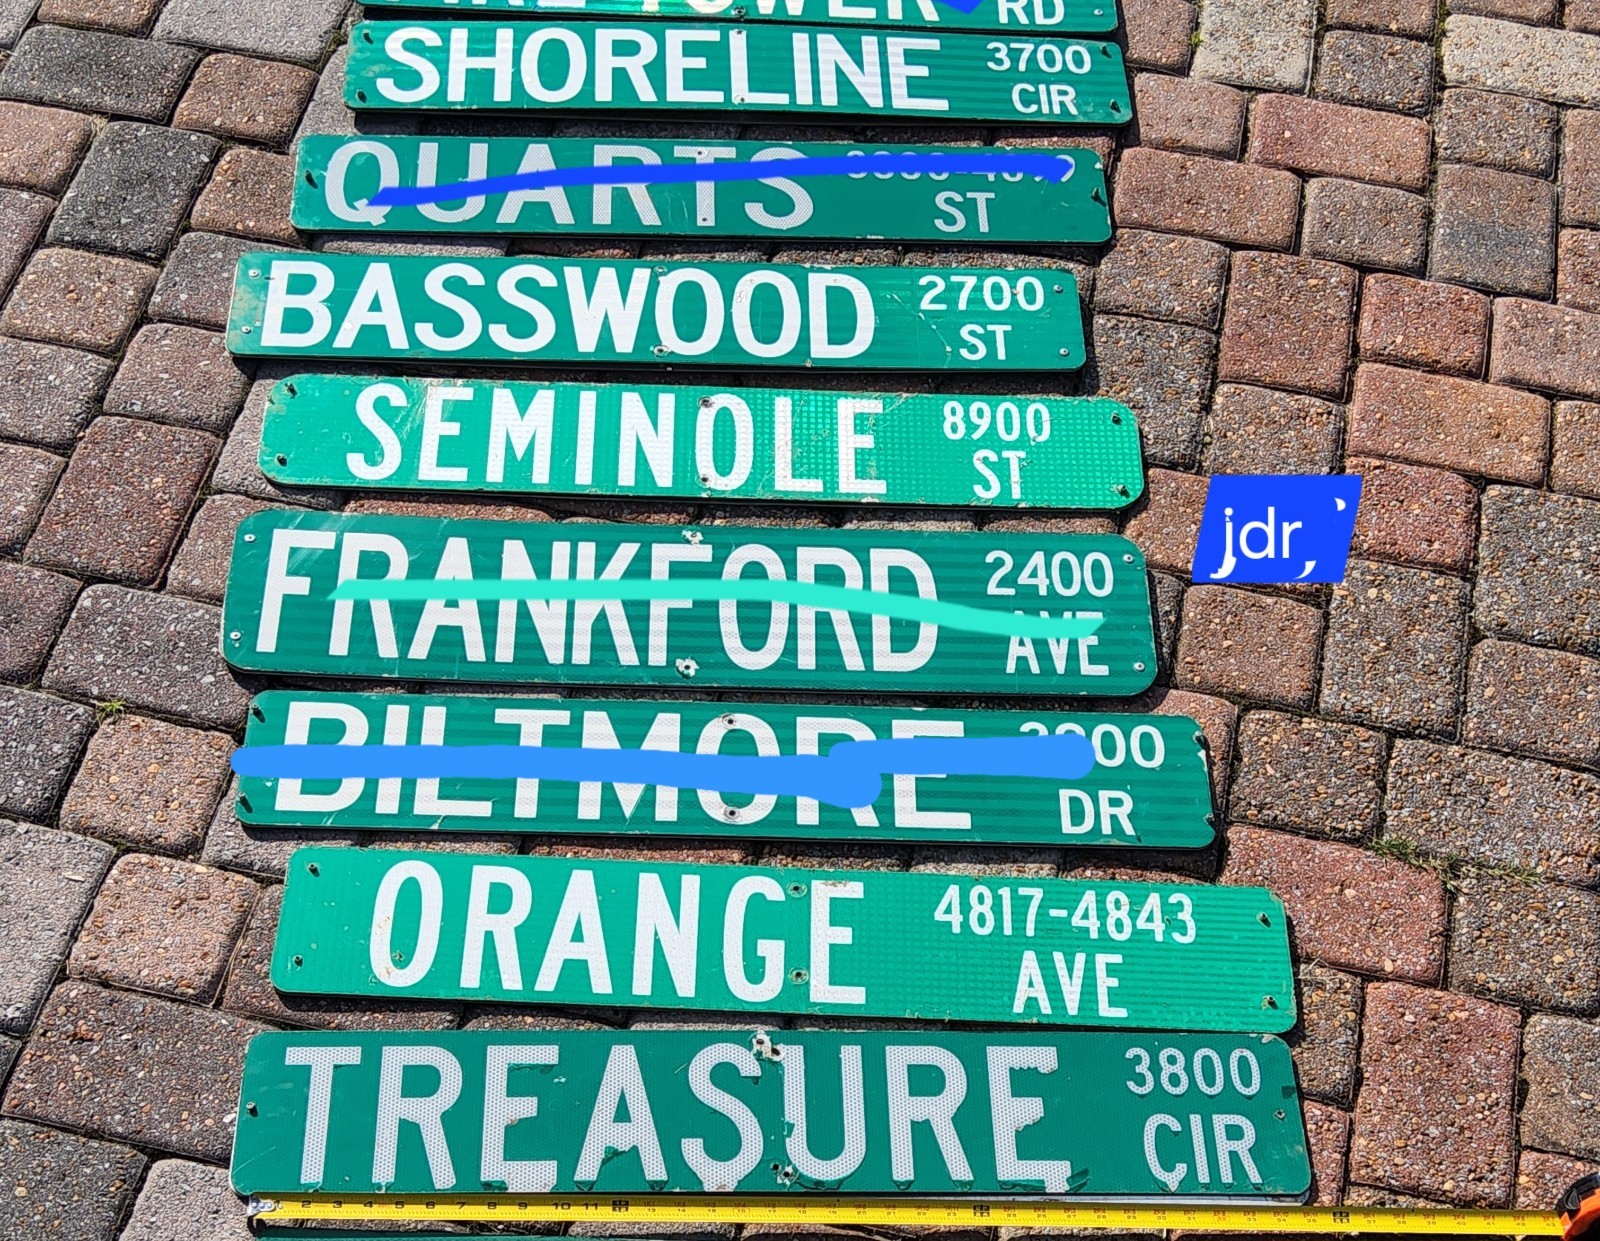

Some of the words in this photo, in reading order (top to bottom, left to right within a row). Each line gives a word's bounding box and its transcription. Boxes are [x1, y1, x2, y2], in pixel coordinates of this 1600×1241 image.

[997, 0, 1065, 26] RD
[375, 27, 950, 111] SHORELINE
[986, 42, 1092, 75] 3700
[1011, 83, 1079, 116] CIR
[323, 140, 814, 230] QUARTS
[934, 190, 995, 233] ST
[259, 260, 876, 359] BASSWOOD
[918, 274, 1045, 312] 2700
[959, 324, 1012, 361] ST
[346, 382, 887, 495] SEMINOLE
[943, 400, 1051, 443] 8900
[972, 448, 1027, 501] ST
[256, 528, 939, 673] FRANKFORD
[985, 550, 1114, 598] 2400
[1005, 610, 1110, 676] AVE
[274, 701, 972, 830] BILTMORE
[1059, 789, 1137, 836] DR
[369, 860, 866, 1004] ORANGE
[933, 884, 1197, 945] 4817-4843
[1013, 951, 1128, 1018] AVE
[1125, 1047, 1262, 1098] 3800
[284, 1042, 1072, 1193] TREASURE
[1143, 1113, 1263, 1192] CIR
[301, 1200, 312, 1208] 2
[332, 1200, 343, 1208] 3
[363, 1201, 374, 1209] 4
[394, 1201, 405, 1209] 5
[425, 1201, 436, 1210] 6
[456, 1202, 467, 1210] 7
[487, 1202, 498, 1210] 8
[518, 1202, 528, 1210] 9
[552, 1203, 572, 1211] 10
[582, 1203, 599, 1211] 11
